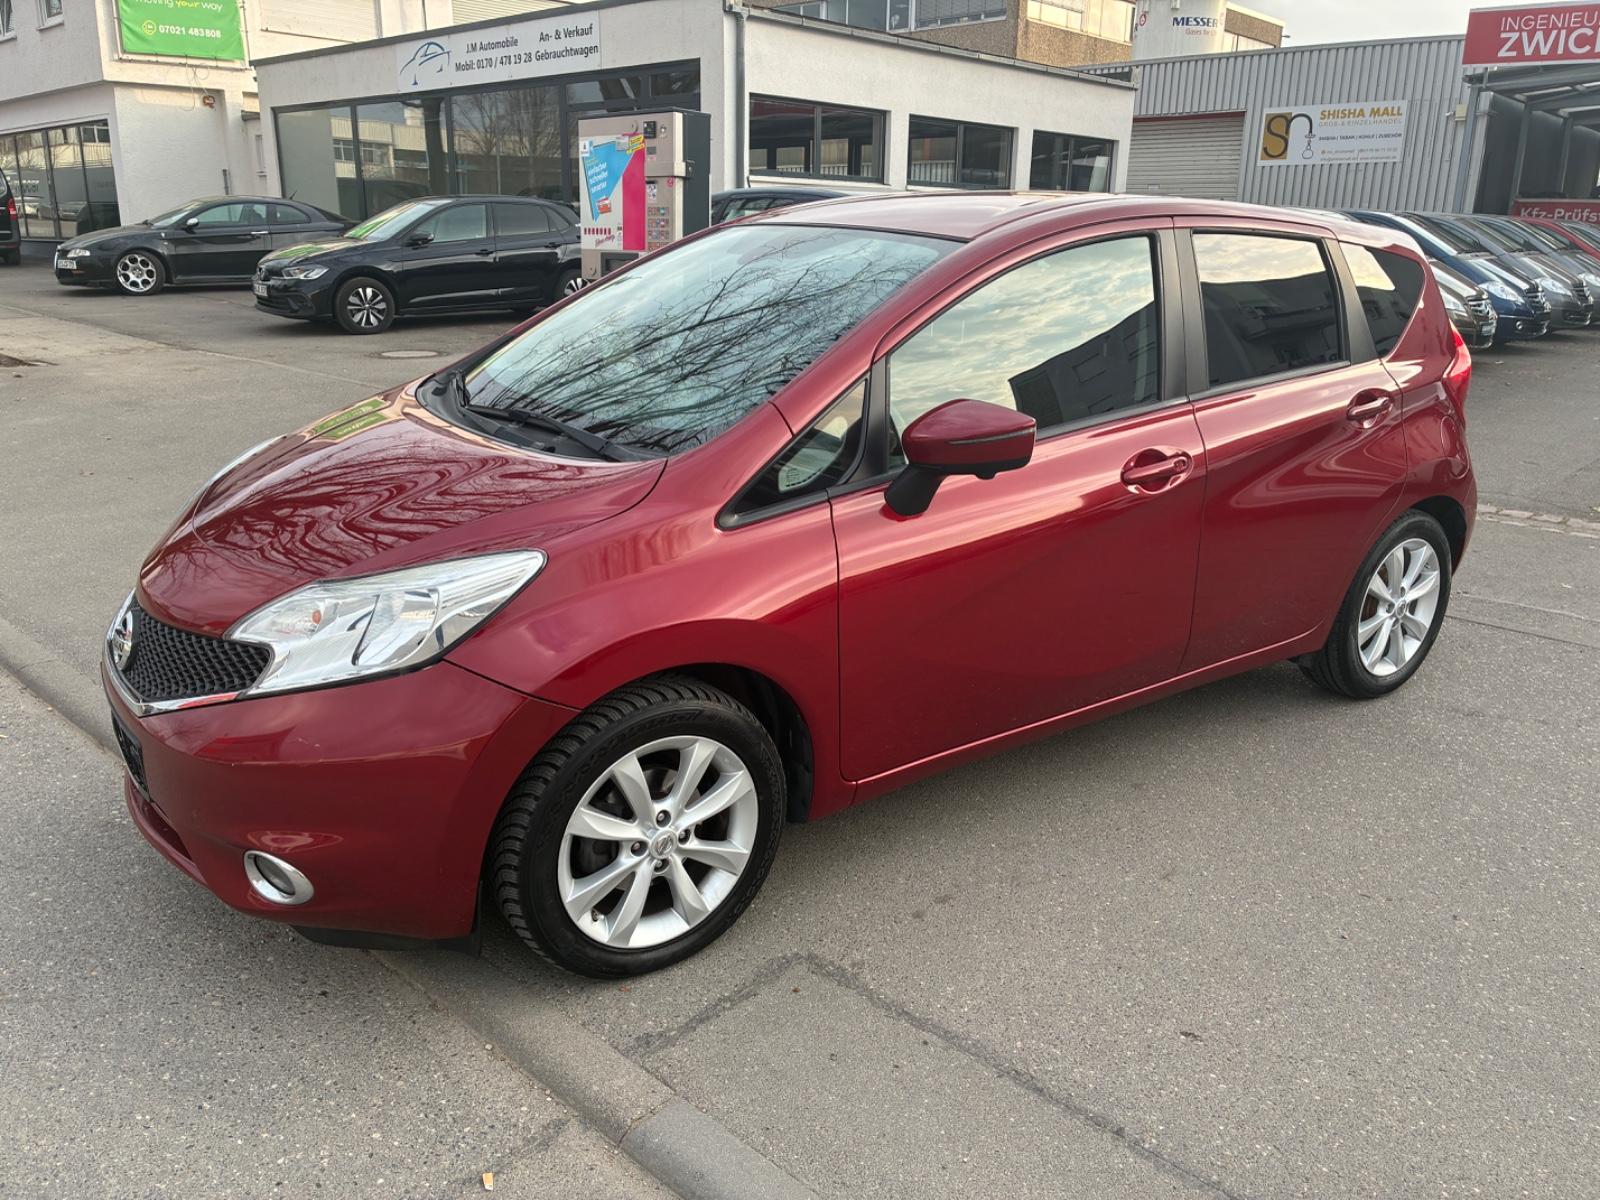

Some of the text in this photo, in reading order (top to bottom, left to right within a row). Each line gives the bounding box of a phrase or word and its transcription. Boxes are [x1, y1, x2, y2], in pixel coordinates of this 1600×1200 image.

[176, 0, 201, 8] your
[201, 2, 223, 13] way
[1172, 16, 1218, 28] MESSER
[1500, 11, 1600, 31] INGENIEU
[159, 25, 186, 35] 07021
[554, 30, 562, 40] &
[563, 23, 594, 38] Verkauf
[479, 34, 519, 52] Automobile
[535, 43, 599, 62] Gebrauchtwagen
[455, 59, 475, 72] Mobil:
[476, 57, 493, 69] 0170
[499, 55, 512, 67] 478
[513, 54, 522, 65] 19
[523, 52, 533, 64] 28
[1320, 105, 1403, 120] SHISHA MALL
